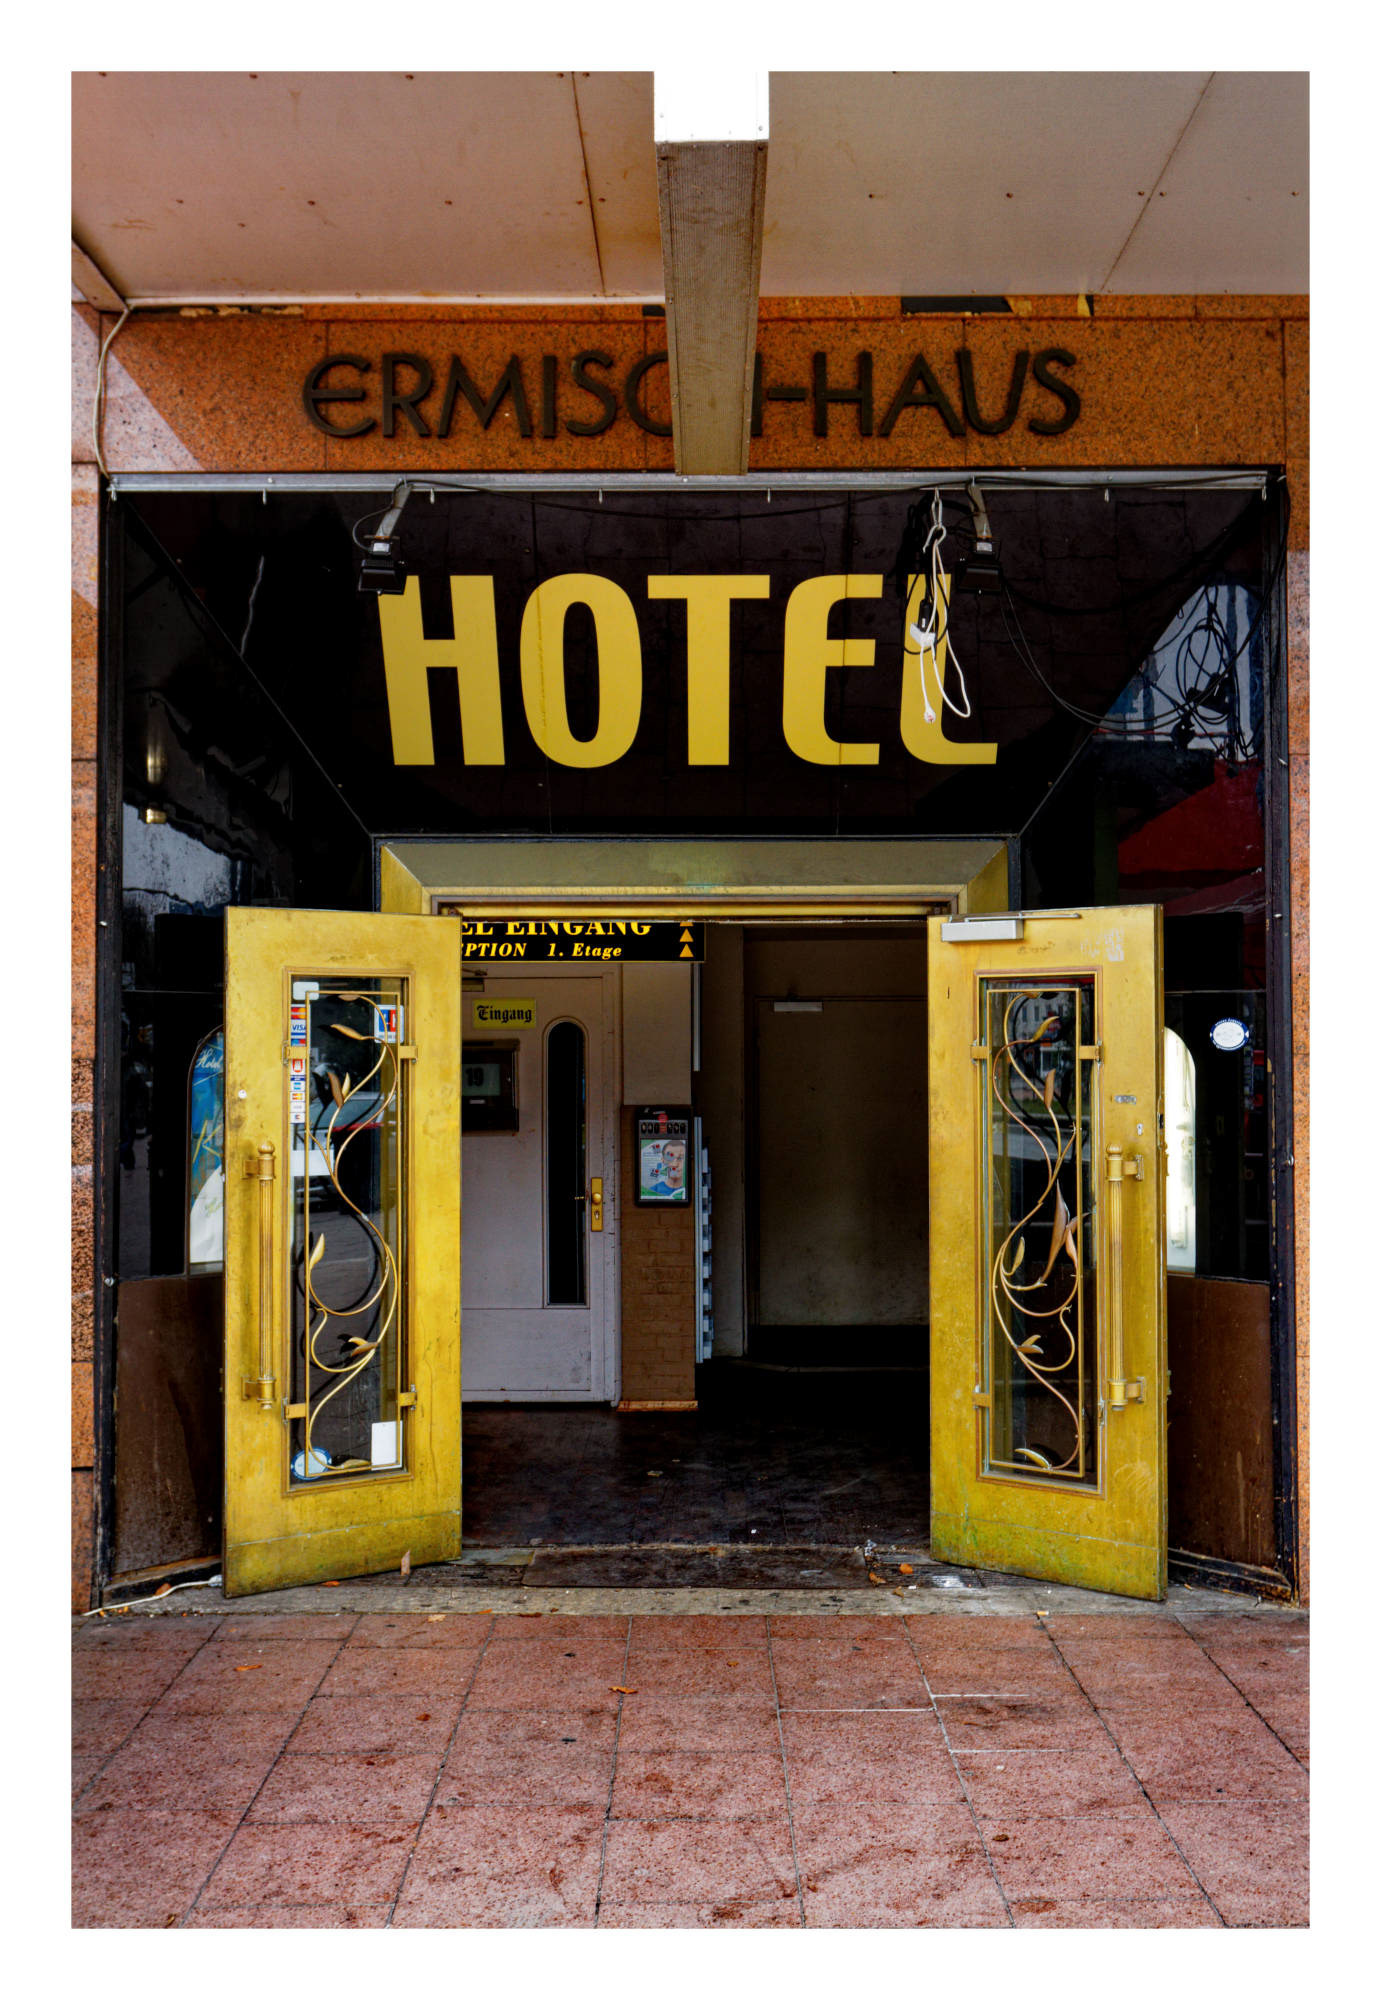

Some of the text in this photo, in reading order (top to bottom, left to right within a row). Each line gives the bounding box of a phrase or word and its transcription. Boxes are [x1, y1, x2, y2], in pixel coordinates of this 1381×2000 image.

[303, 349, 1083, 439] ERMISC-HAUS
[377, 573, 998, 768] HOTEL
[505, 922, 652, 936] EINGANG
[461, 943, 622, 960] PTION 1. Etage
[477, 1005, 533, 1024] Eingang
